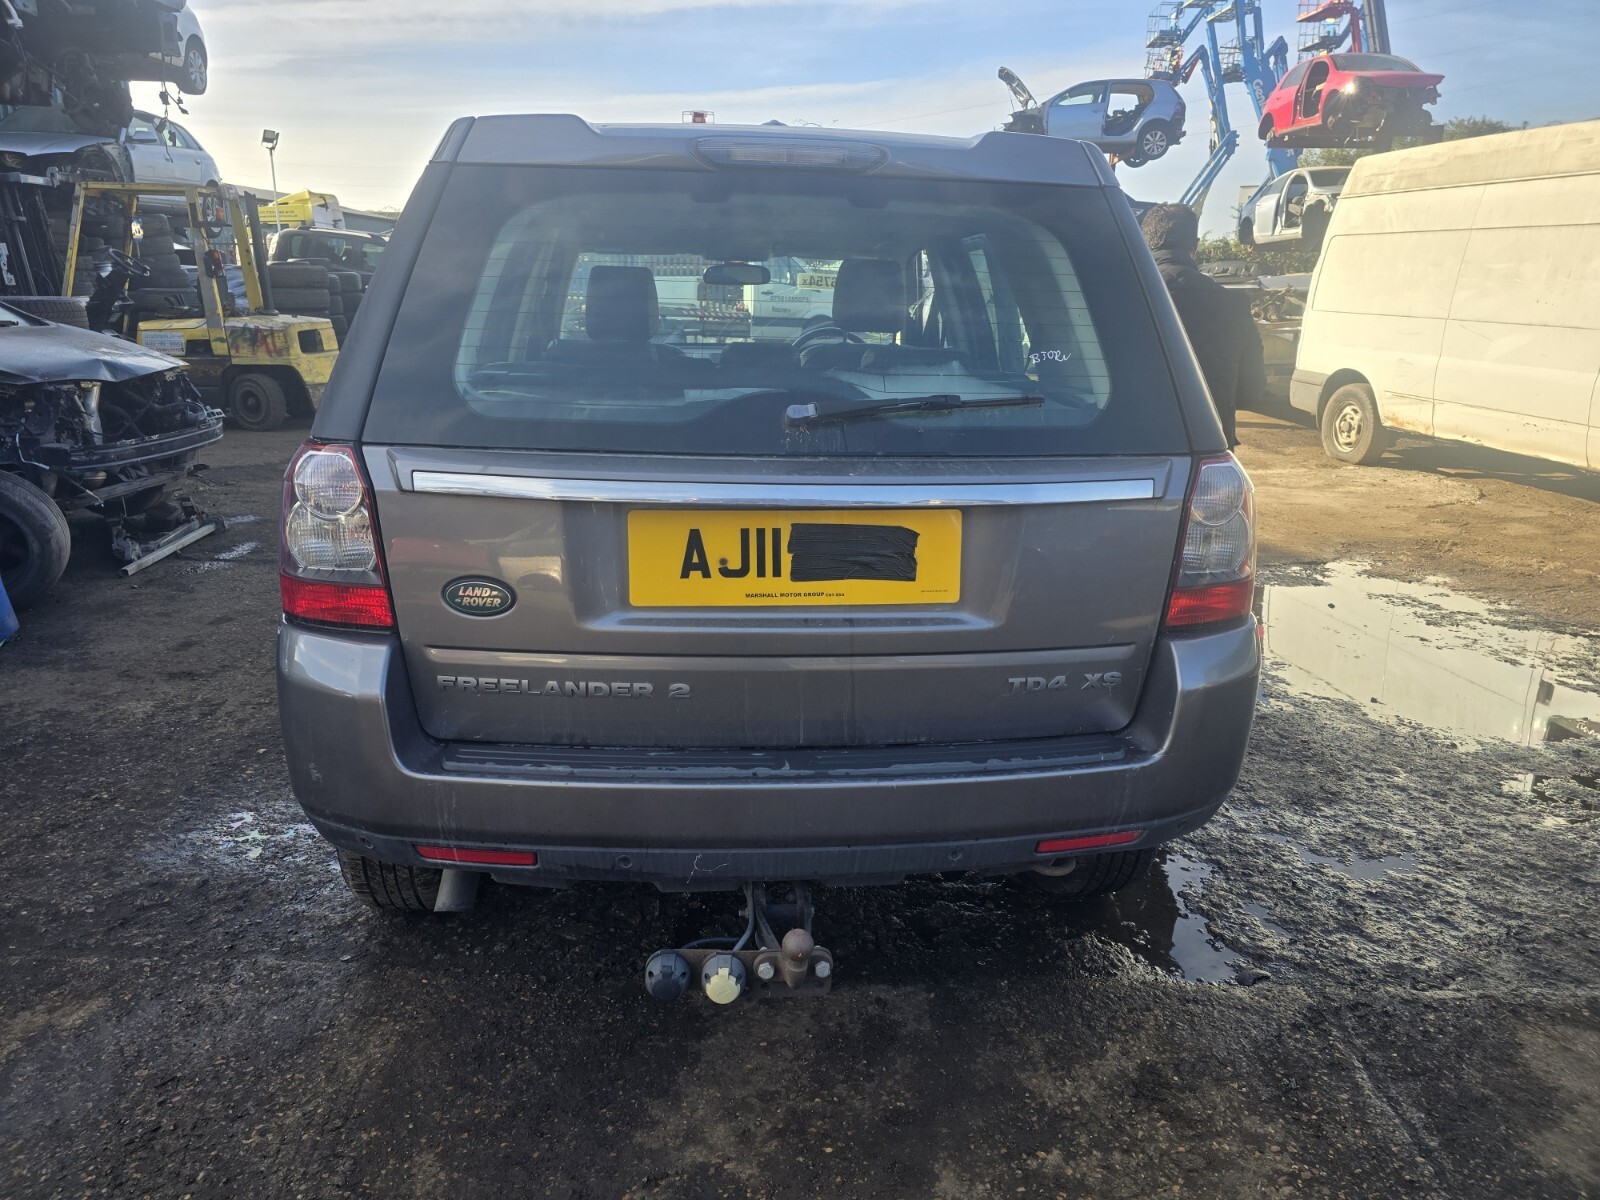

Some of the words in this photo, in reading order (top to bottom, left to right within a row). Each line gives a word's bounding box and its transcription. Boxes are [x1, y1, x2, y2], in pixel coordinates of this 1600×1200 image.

[458, 586, 491, 597] LAND
[461, 597, 501, 608] ROVER
[437, 675, 654, 699] FREELANDER
[668, 683, 692, 699] 2
[1008, 675, 1067, 692] TD4
[1081, 671, 1122, 690] XS
